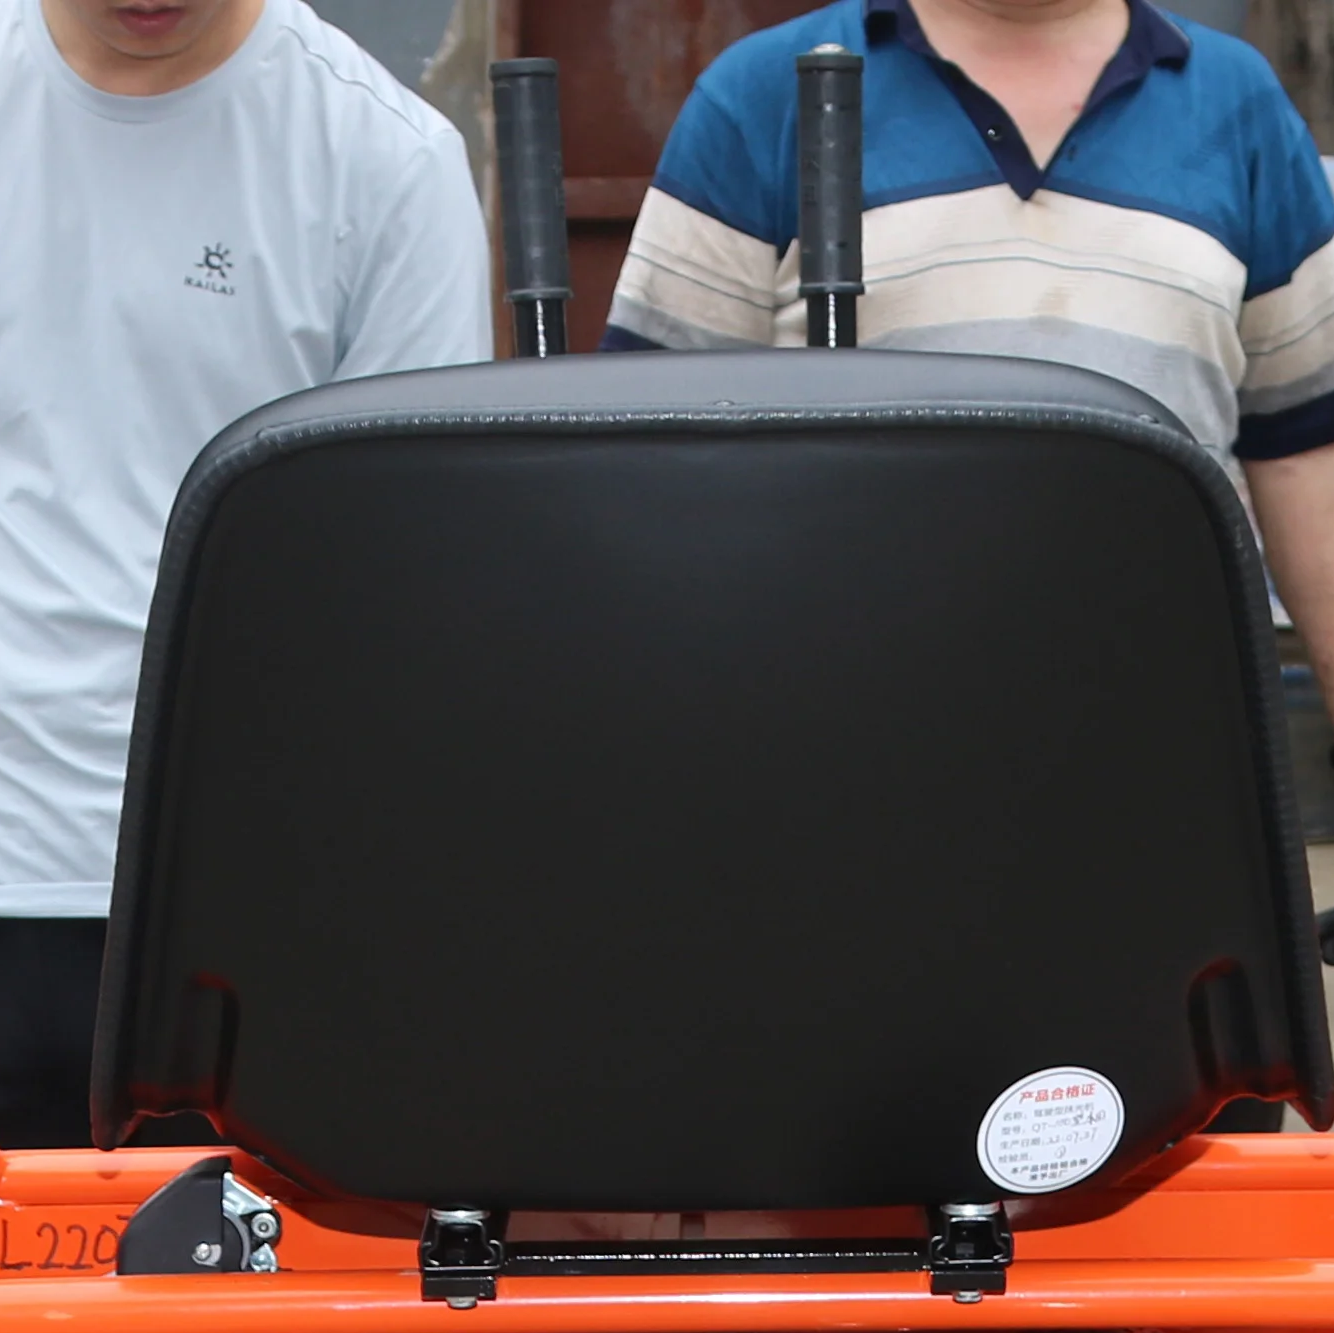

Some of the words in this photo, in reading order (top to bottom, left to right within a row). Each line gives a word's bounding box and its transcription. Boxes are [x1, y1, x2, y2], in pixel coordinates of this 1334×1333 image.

[1018, 1083, 1097, 1104] 产品合格证
